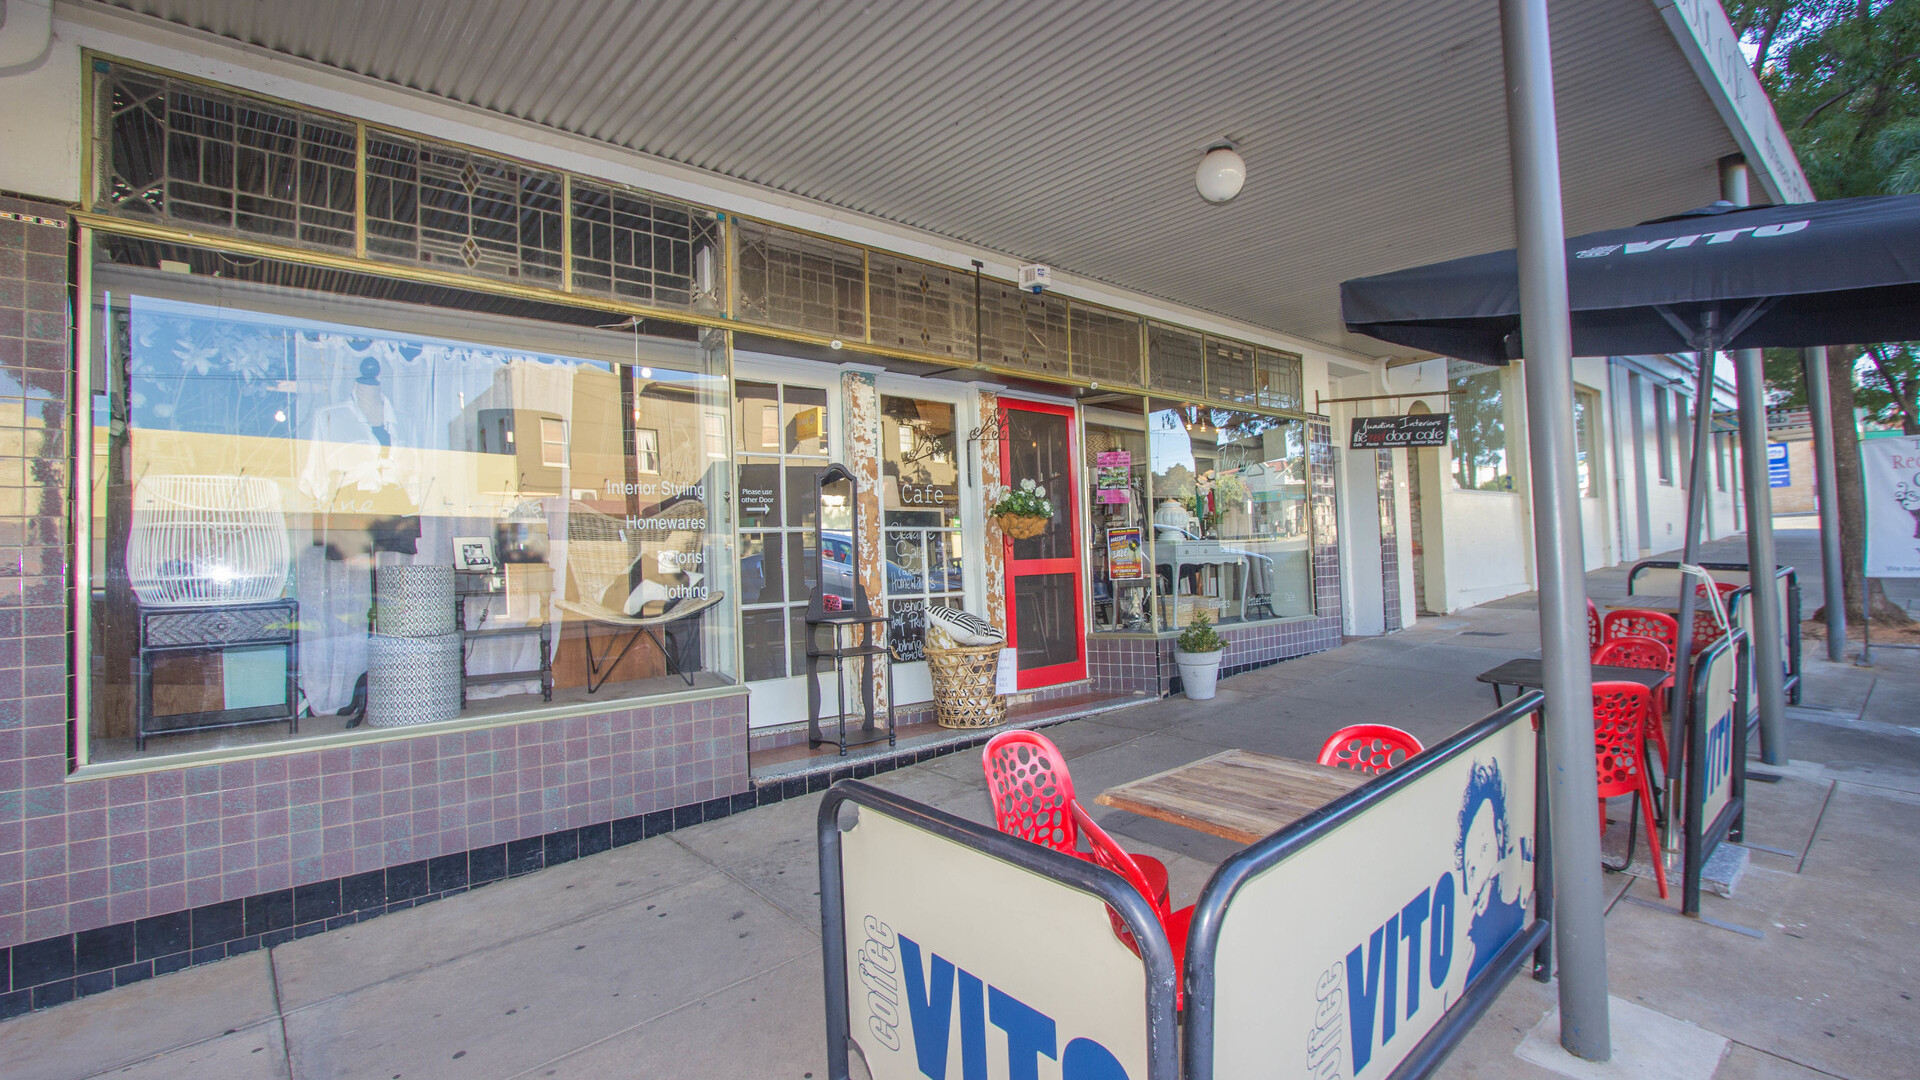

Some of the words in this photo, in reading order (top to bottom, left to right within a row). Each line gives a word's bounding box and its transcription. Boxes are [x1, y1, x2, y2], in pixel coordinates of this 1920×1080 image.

[1624, 219, 1810, 254] VITO
[1385, 429, 1413, 442] door
[1415, 427, 1444, 441] cafe
[607, 480, 657, 496] Interior
[660, 480, 705, 500] Styling
[901, 484, 944, 504] Cafe
[625, 514, 706, 530] Homewares
[674, 549, 707, 565] lorist
[857, 914, 901, 1052] coffee
[1345, 870, 1456, 1078] VITO
